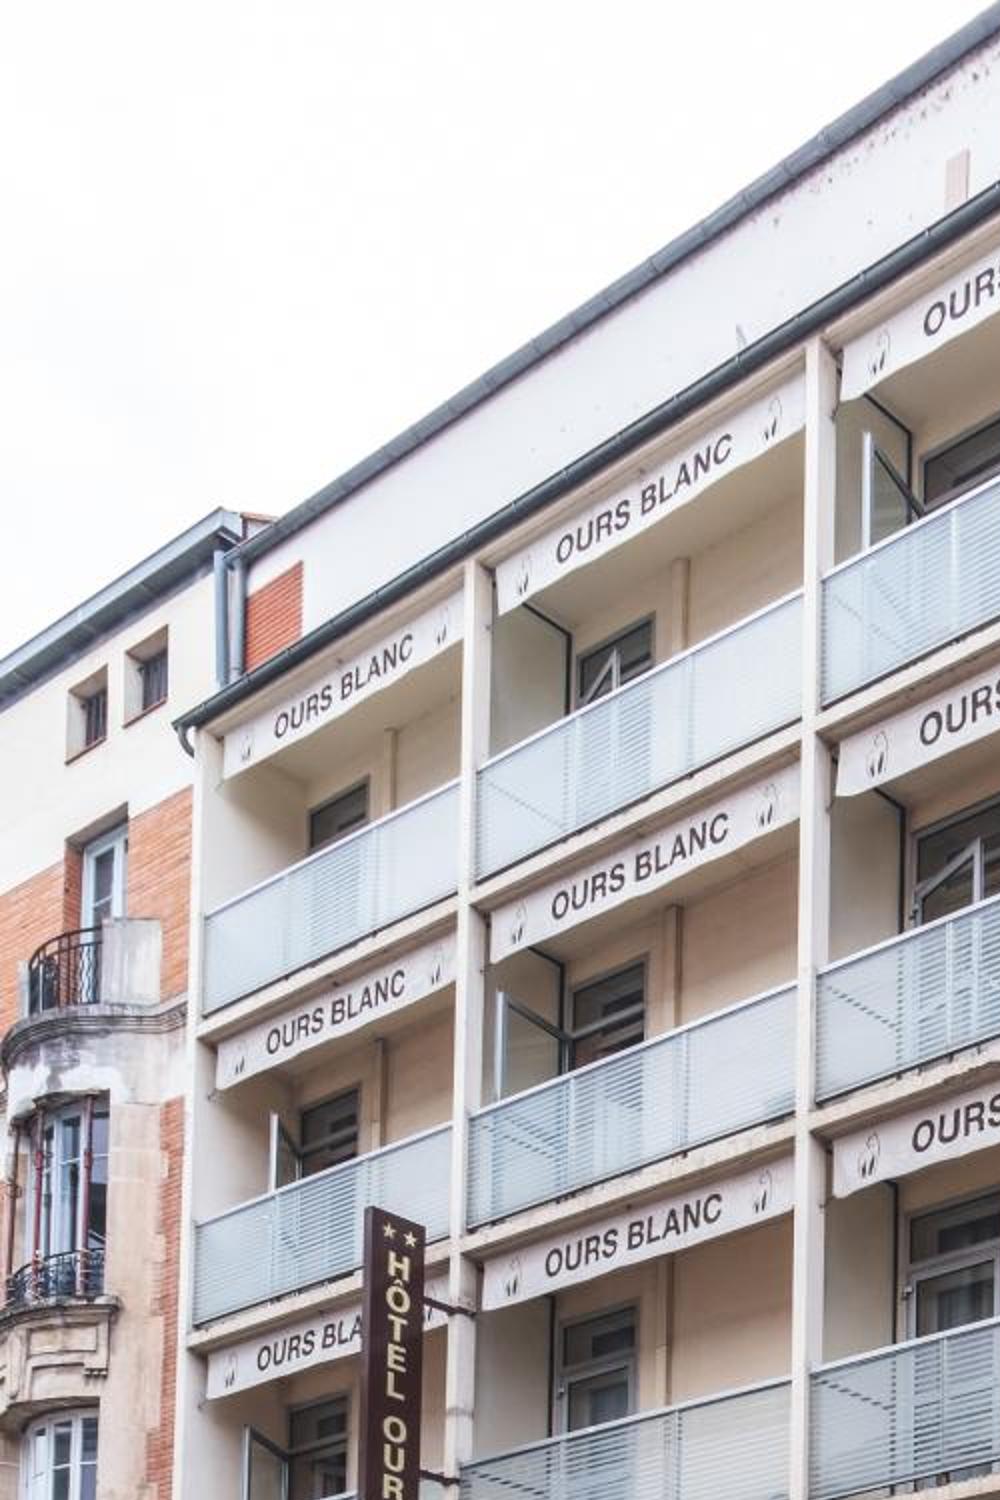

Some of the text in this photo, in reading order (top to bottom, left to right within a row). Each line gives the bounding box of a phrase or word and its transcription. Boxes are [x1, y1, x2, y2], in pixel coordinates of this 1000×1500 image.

[555, 432, 733, 565] OURS BLANC
[273, 633, 414, 740] OURS BLANC
[552, 813, 729, 920] OURS BLANC
[267, 970, 406, 1055] OURS BLANC
[545, 1193, 723, 1280] OURS BLANC
[257, 1315, 362, 1371] OURS BLA
[386, 1251, 412, 1400] HÔTEL
